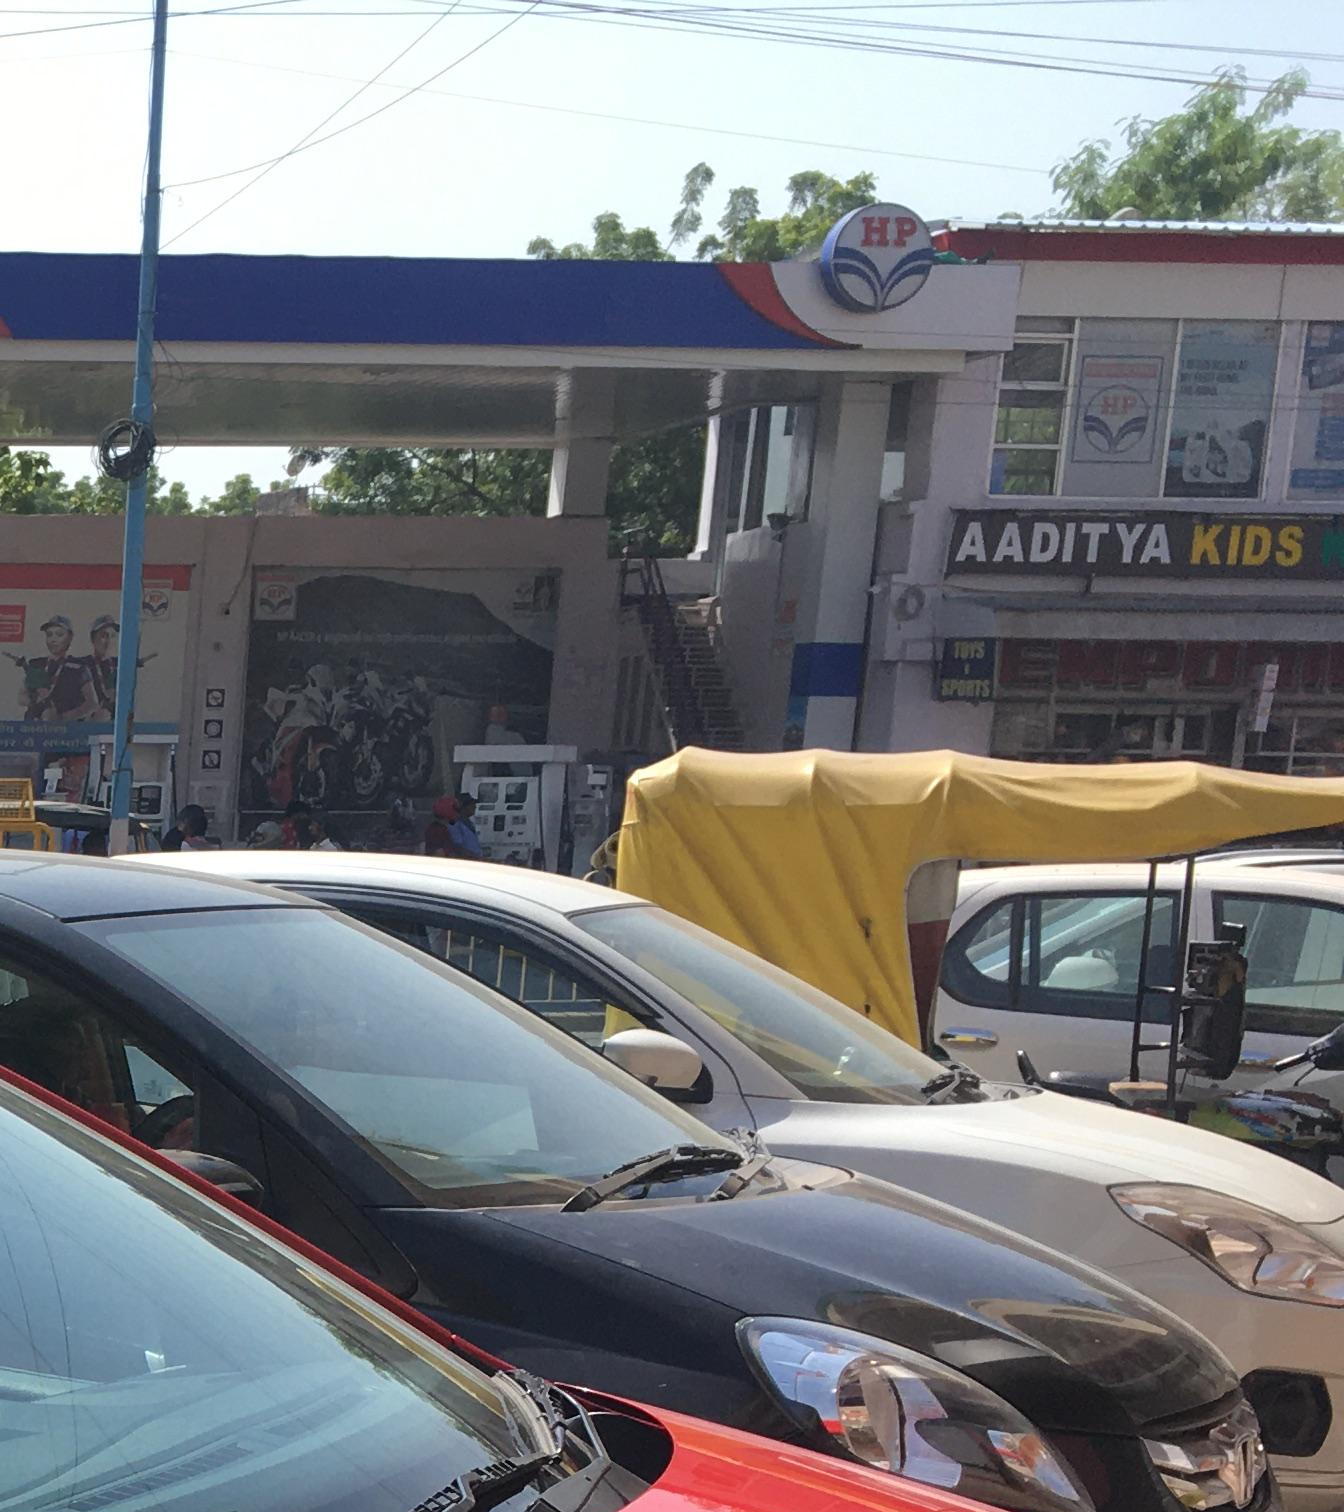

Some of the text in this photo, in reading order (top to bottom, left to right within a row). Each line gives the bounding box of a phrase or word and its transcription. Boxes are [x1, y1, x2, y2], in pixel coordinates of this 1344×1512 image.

[860, 217, 917, 248] HP
[1100, 395, 1138, 417] HP
[955, 521, 1171, 565] AADITYA
[1189, 523, 1305, 568] KIDS
[941, 678, 992, 699] SPORTS
